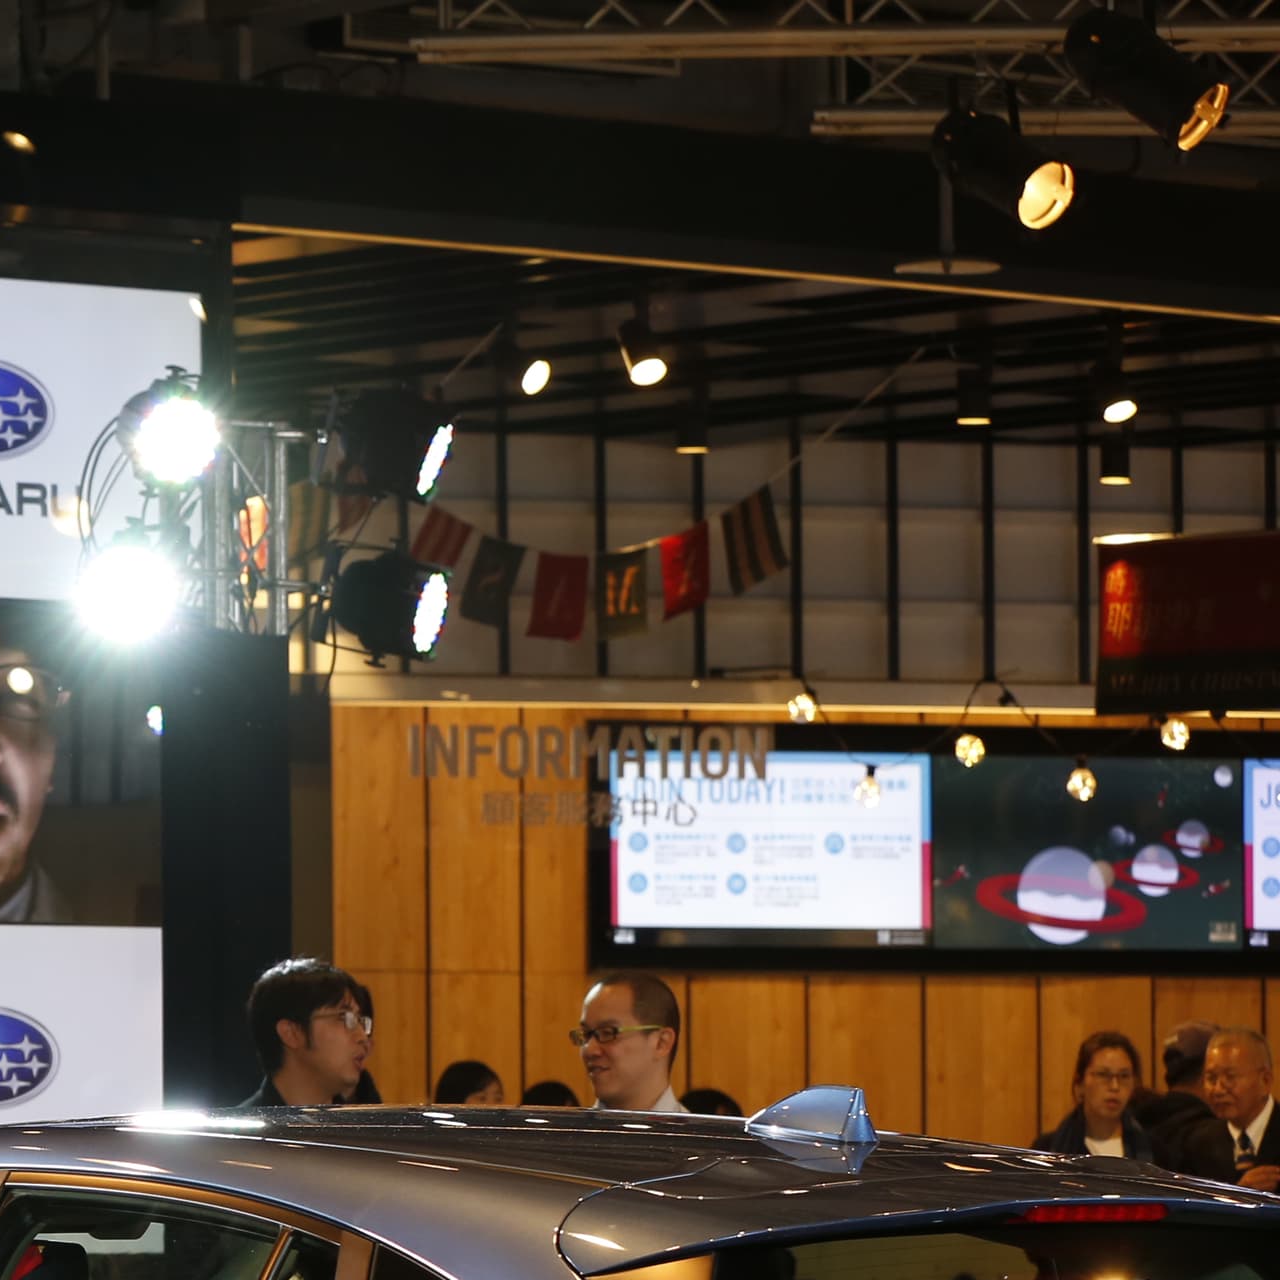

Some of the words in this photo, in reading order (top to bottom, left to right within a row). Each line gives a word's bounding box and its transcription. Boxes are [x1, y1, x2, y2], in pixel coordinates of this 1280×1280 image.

[408, 723, 774, 782] INFORMATION
[480, 788, 699, 829] 顧客服務中心
[694, 777, 785, 806] TODAY!
